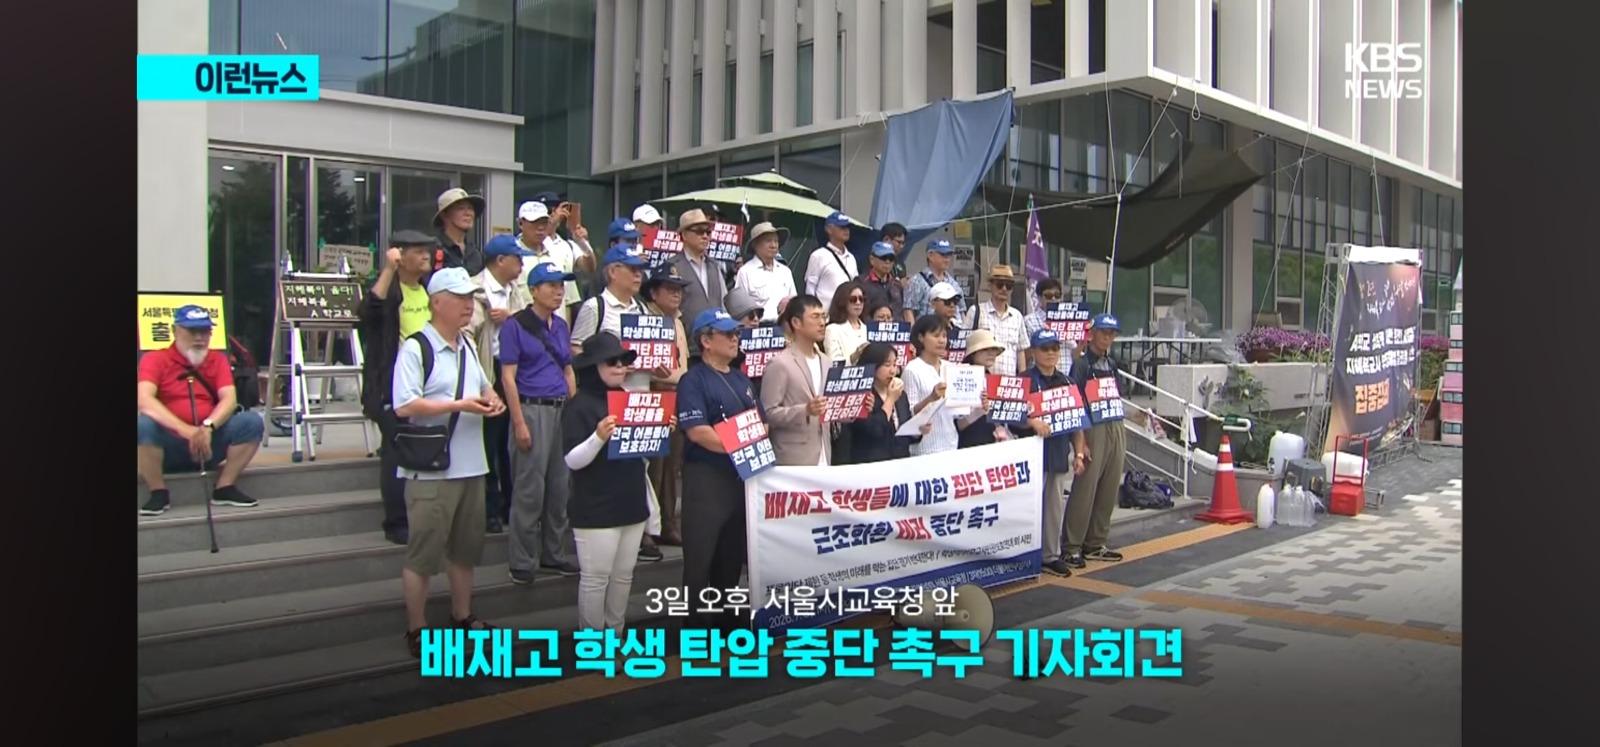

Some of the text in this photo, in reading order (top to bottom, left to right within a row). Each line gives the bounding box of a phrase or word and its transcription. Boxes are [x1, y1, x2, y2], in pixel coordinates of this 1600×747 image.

[638, 316, 663, 327] 배재고
[878, 322, 899, 332] 배재고
[623, 326, 674, 340] 학생들에 대한
[752, 327, 773, 338] 배재고
[896, 332, 910, 342] 대한
[654, 344, 671, 355] 테러
[841, 366, 864, 379] 배재고
[826, 378, 873, 392] 학생들에 대한
[1000, 377, 1023, 388] 배재고
[628, 393, 662, 407] 배재고
[846, 394, 864, 406] 테러
[1042, 387, 1069, 400] 배재고
[624, 408, 664, 422] 학생들을
[634, 426, 670, 439] 어른들이
[619, 438, 661, 452] 보호하자!
[764, 460, 1030, 520] 배재고 학생들에 대한 집단 탄압과
[812, 521, 893, 555] 근조화환
[930, 511, 964, 537] 중단
[968, 503, 998, 529] 촉구
